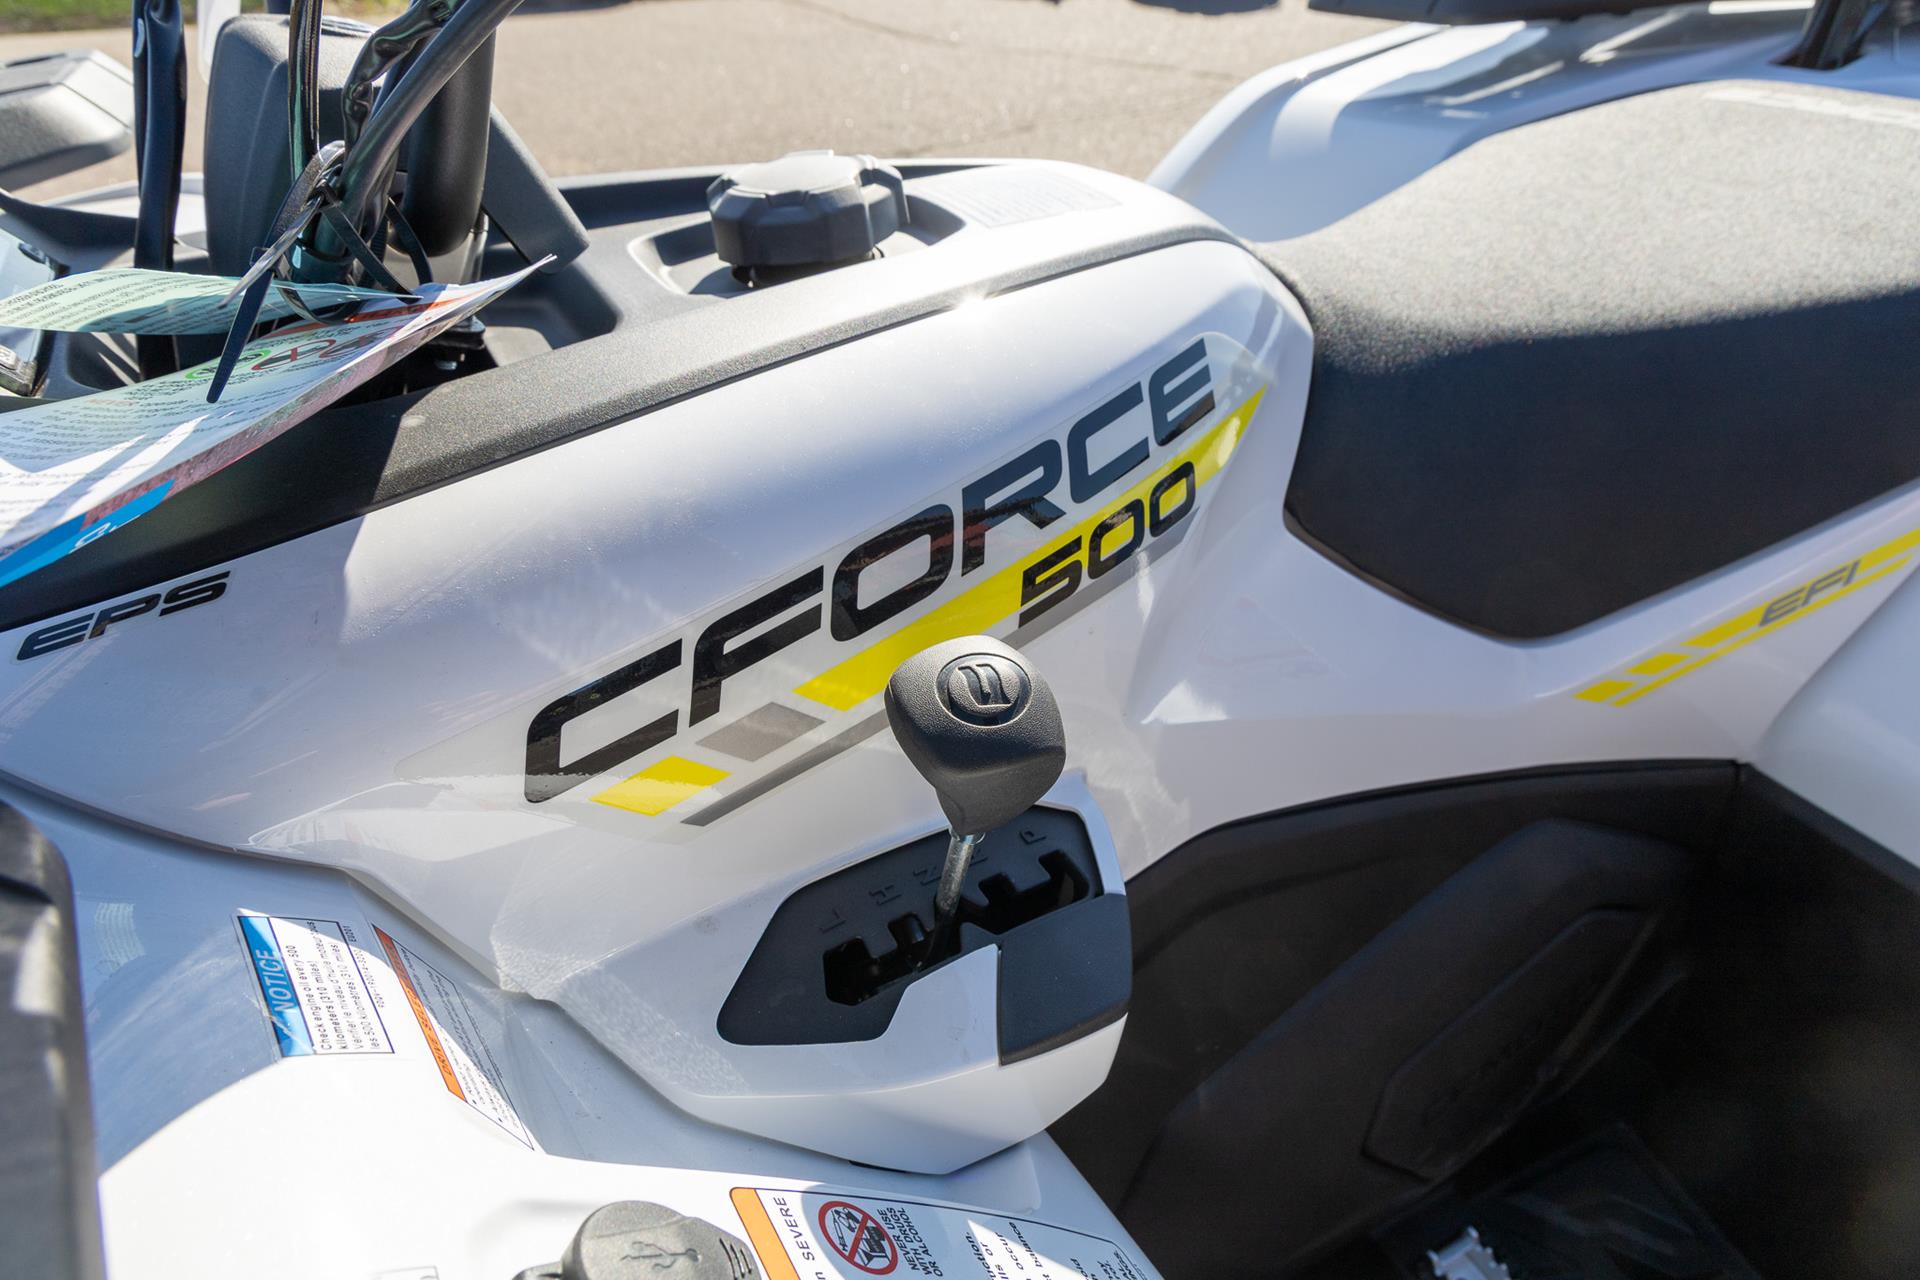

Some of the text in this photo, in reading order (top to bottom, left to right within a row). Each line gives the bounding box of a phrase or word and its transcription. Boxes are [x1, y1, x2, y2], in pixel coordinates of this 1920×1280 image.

[525, 337, 1215, 804] CFORCE
[1018, 460, 1197, 628] 500
[16, 570, 231, 661] EPS
[1758, 560, 1861, 627] EFI
[255, 949, 295, 1011] NOTICE
[286, 944, 331, 1049] Check engine oil every 500
[324, 1004, 347, 1049] kilometers
[773, 1196, 815, 1261] SEVERE
[877, 1208, 896, 1230] USE
[886, 1207, 933, 1275] WITH DRUGS
[897, 1207, 943, 1277] OR ALCOHOL
[980, 1241, 994, 1256] or
[994, 1231, 1024, 1270] occur
[1008, 1221, 1043, 1268] balance
[892, 1234, 920, 1271] NEVER
